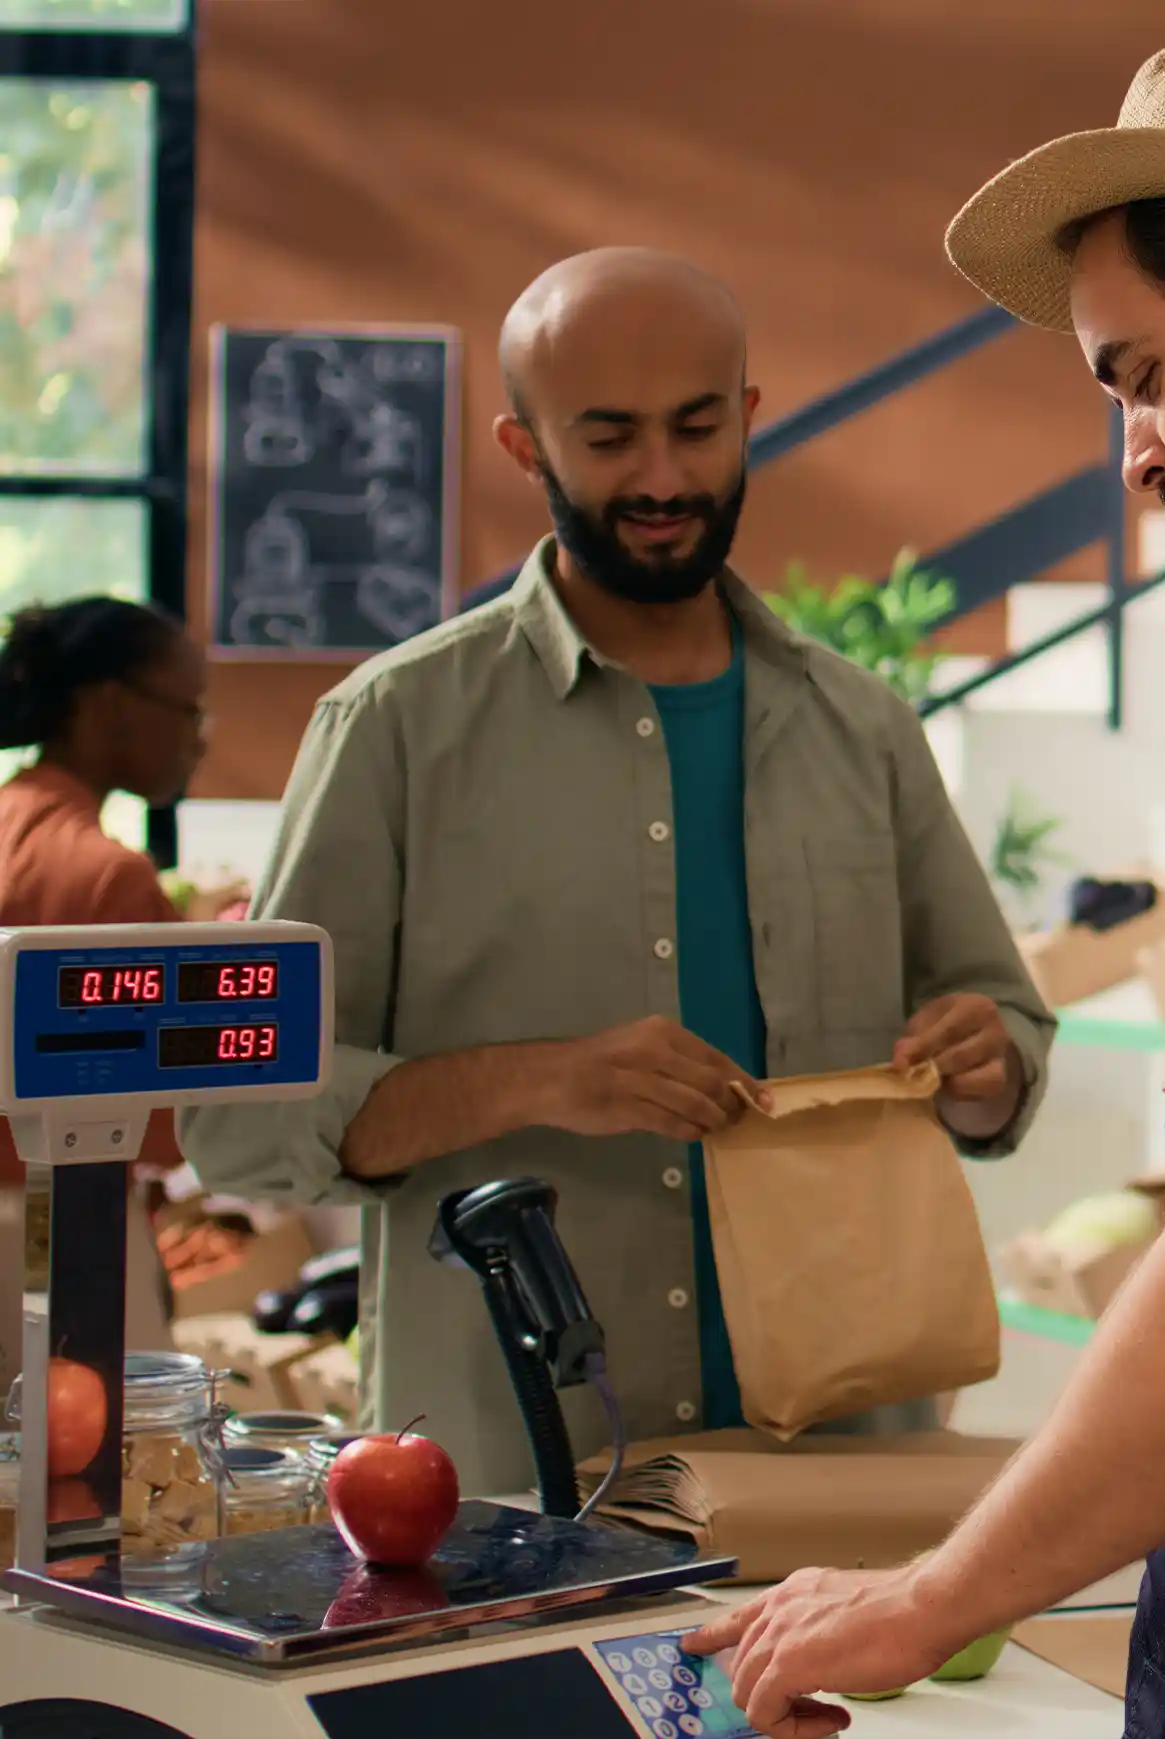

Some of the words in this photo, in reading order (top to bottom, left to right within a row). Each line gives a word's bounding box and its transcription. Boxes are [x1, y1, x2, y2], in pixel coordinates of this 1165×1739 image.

[82, 970, 160, 1002] 0.146
[218, 966, 275, 997] 6.39
[218, 1027, 275, 1058] 0.93
[677, 1668, 694, 1683] 6
[668, 1694, 685, 1709] 2
[658, 1721, 674, 1738] 0
